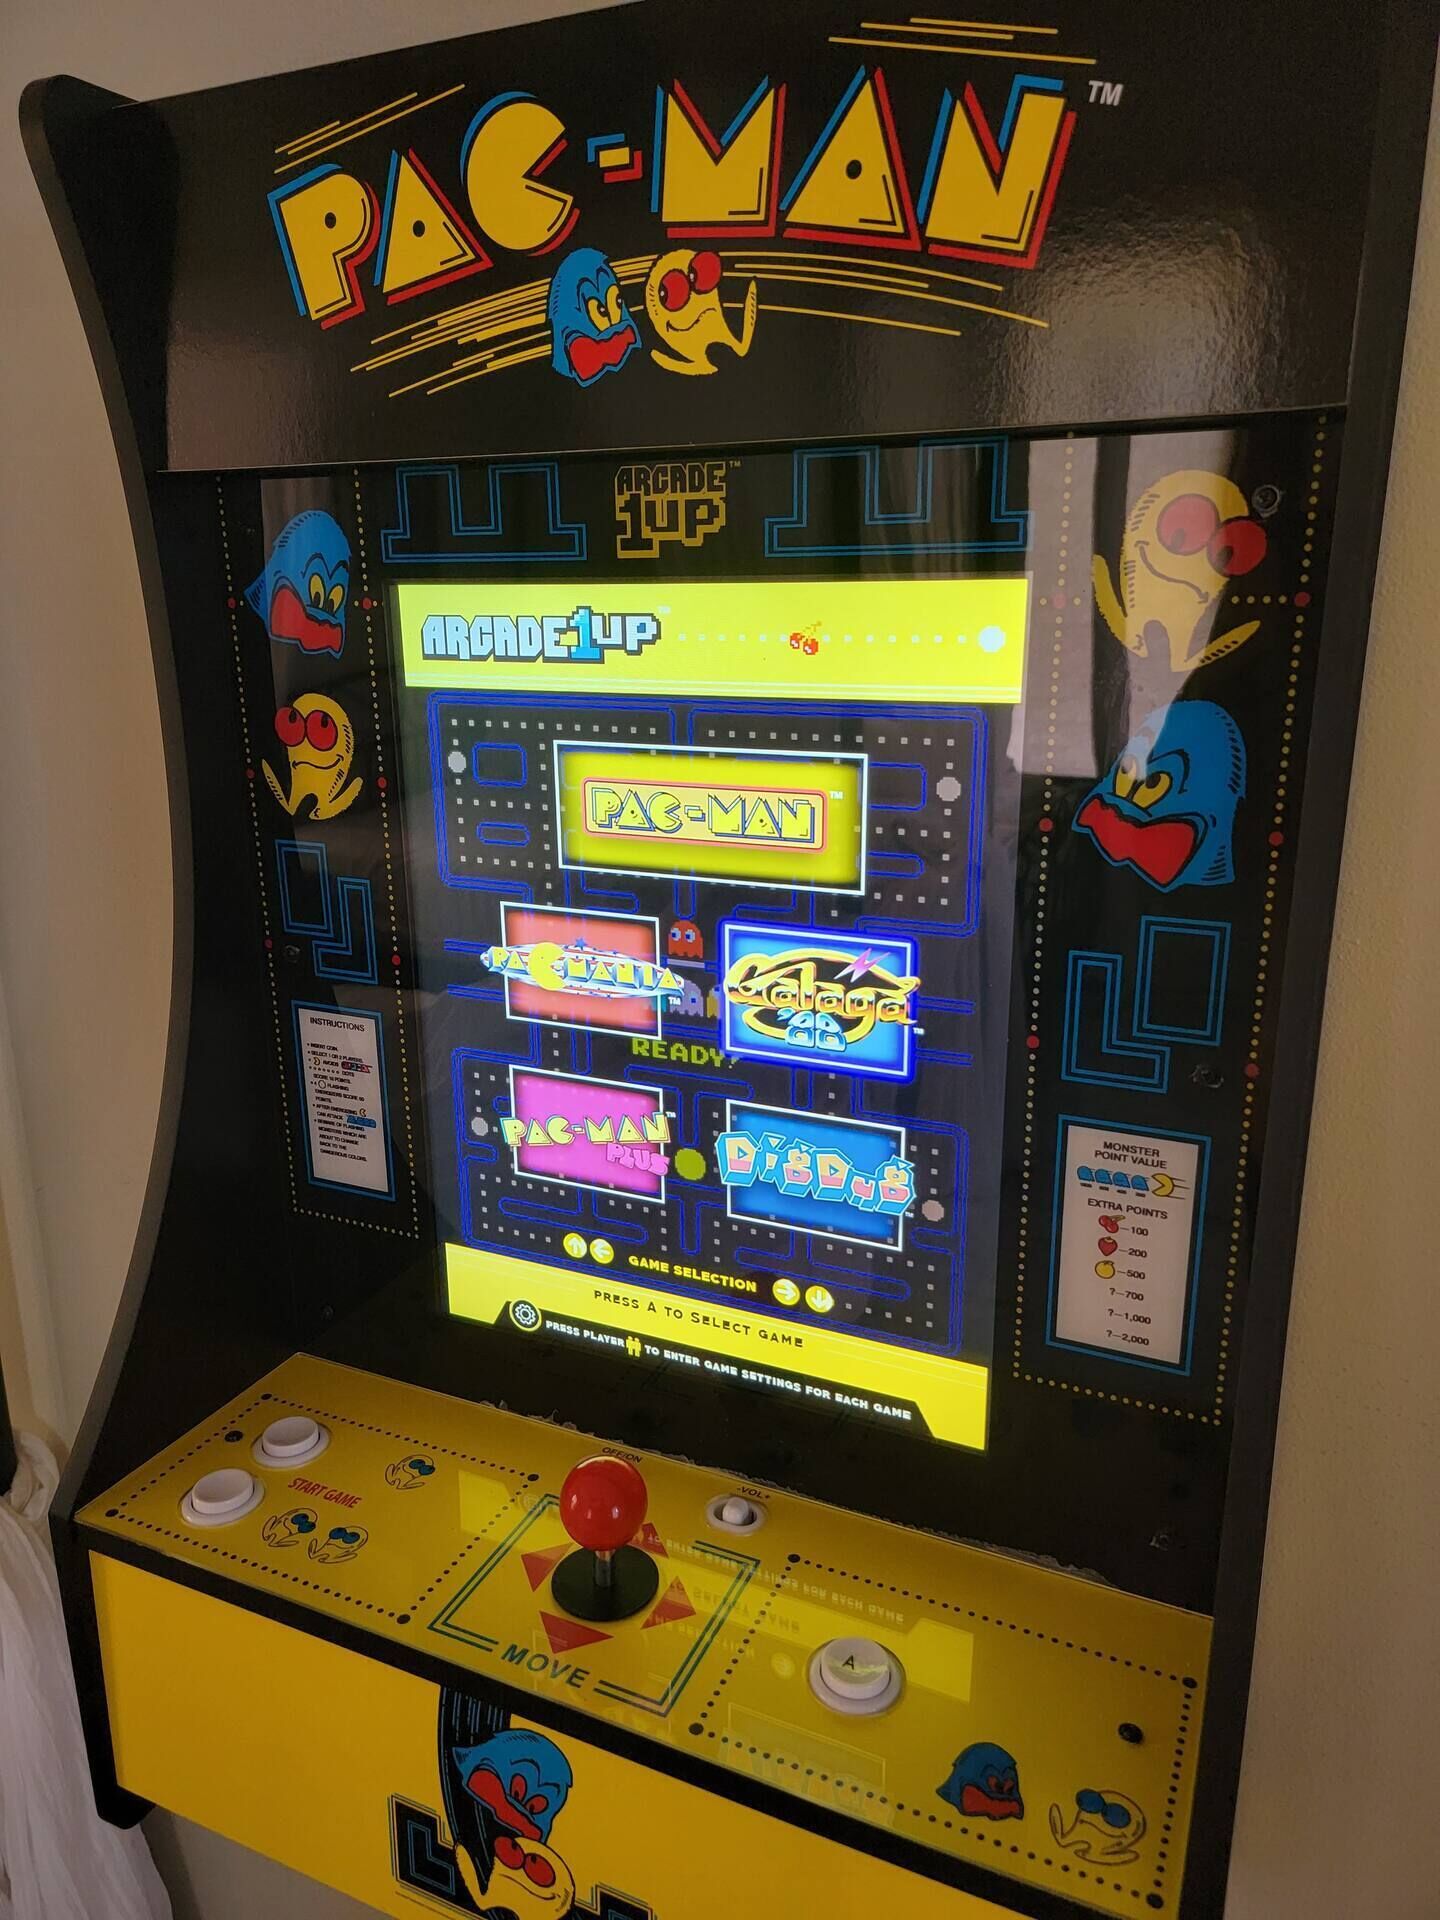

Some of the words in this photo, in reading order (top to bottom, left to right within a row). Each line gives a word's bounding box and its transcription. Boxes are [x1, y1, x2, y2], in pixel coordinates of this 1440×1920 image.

[268, 64, 1077, 329] PAC-MAN
[615, 462, 726, 497] ARCADE
[616, 493, 726, 559] 1UP
[591, 787, 815, 843] PAC-MAN
[310, 1017, 365, 1032] INSTRUCTIONS
[500, 1112, 671, 1146] PAC-MAN
[606, 1142, 670, 1176] PLUS
[1094, 1150, 1129, 1163] POINT
[1131, 1156, 1168, 1169] VALUE
[1103, 1141, 1160, 1158] MONSTER
[1087, 1198, 1123, 1212] EXTRA
[1126, 1204, 1168, 1220] POINTS
[628, 1255, 670, 1273] GAME
[673, 1265, 757, 1293] SELECTION
[594, 1290, 640, 1309] PRESS
[647, 1301, 657, 1313] A
[664, 1306, 683, 1319] TO
[691, 1312, 751, 1336] SELECT
[758, 1329, 803, 1348] GAME
[545, 1319, 580, 1337] PRESS
[583, 1328, 625, 1348] PLAYER
[644, 1344, 660, 1356] TO
[663, 1349, 701, 1367] ENTER
[703, 1360, 738, 1376] GAME
[741, 1368, 802, 1393] SETTINGS
[805, 1385, 831, 1400] FOR
[835, 1392, 869, 1410] EACH
[873, 1402, 912, 1421] GAME
[288, 1477, 328, 1497] START
[323, 1489, 362, 1509] GAME
[501, 1643, 591, 1689] MOVE
[842, 1655, 854, 1670] A
